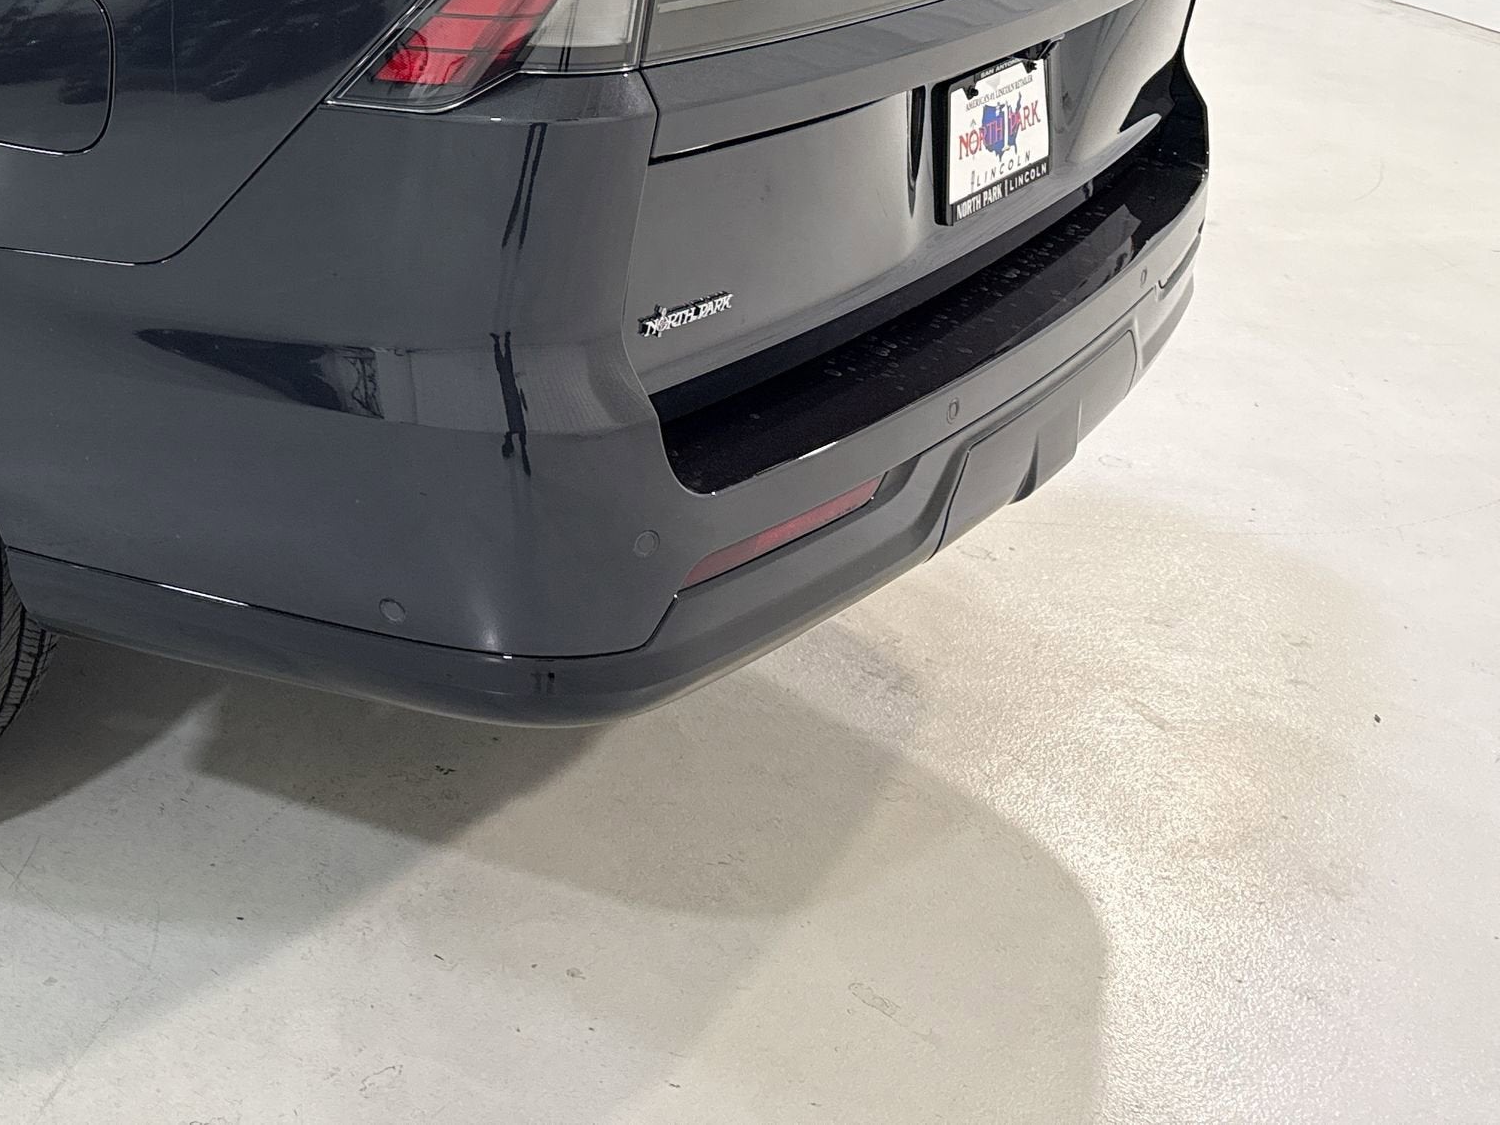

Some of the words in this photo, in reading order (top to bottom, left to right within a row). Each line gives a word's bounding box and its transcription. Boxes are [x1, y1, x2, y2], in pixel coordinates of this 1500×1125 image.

[958, 117, 1003, 161] NORTH
[1010, 100, 1041, 135] PARK
[956, 192, 982, 221] NORTH
[983, 184, 1003, 207] PARK
[1009, 162, 1047, 191] LINCOLN
[976, 150, 1031, 187] LINCOLN
[644, 307, 697, 338] NORTH
[698, 293, 734, 320] PARK
